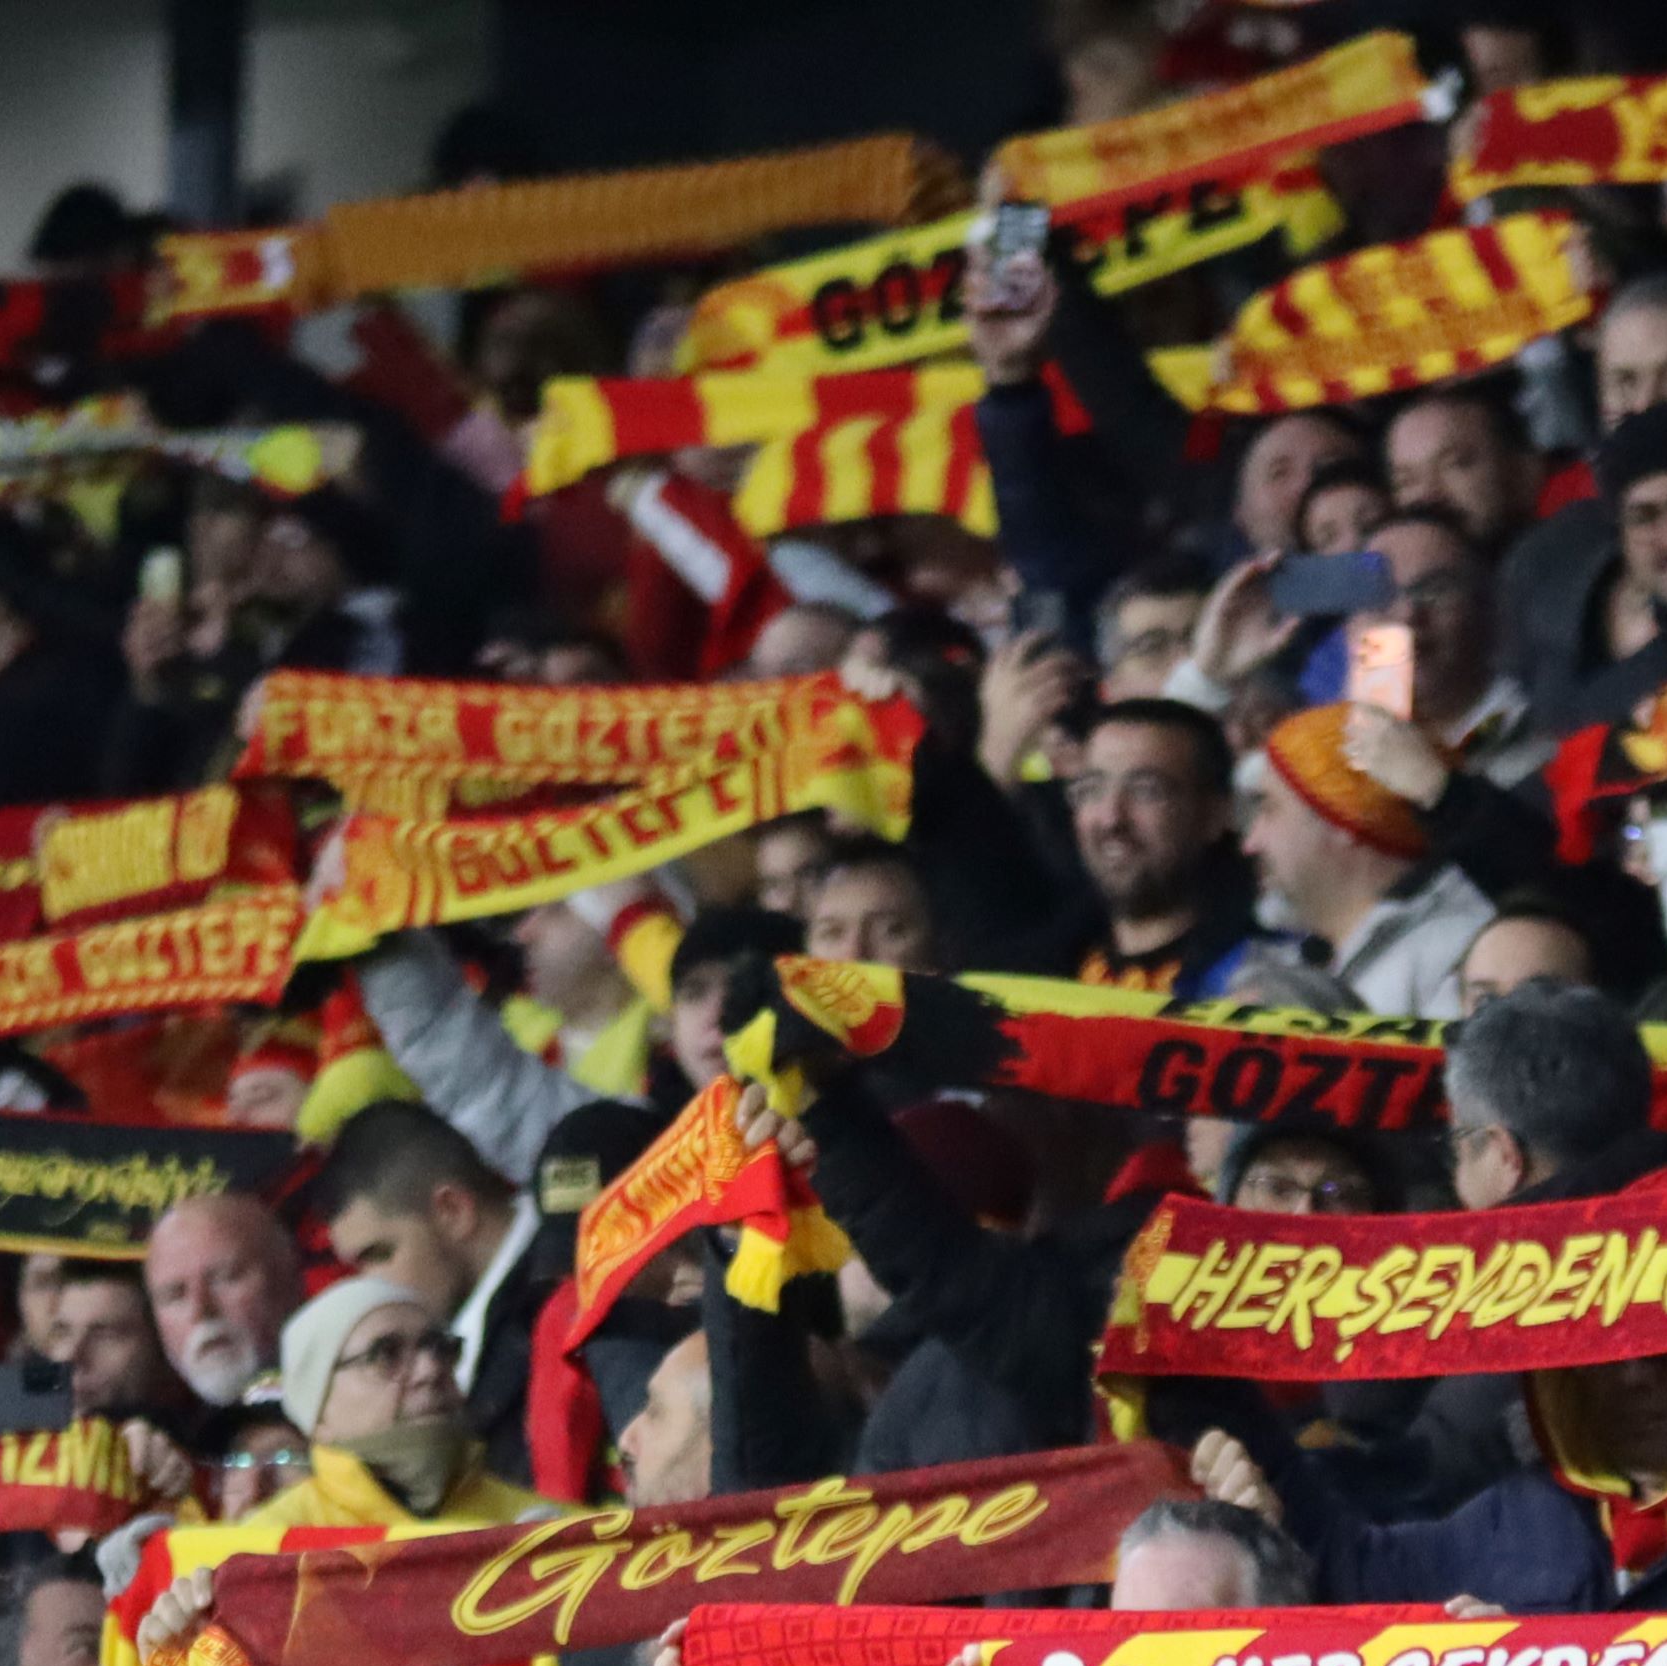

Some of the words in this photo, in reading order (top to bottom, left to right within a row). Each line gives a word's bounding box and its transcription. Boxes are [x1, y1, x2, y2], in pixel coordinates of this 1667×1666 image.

[1170, 1240, 1340, 1350] HER
[1335, 1228, 1660, 1363] ŞEYDEN
[449, 1475, 1051, 1647] Göztepe
